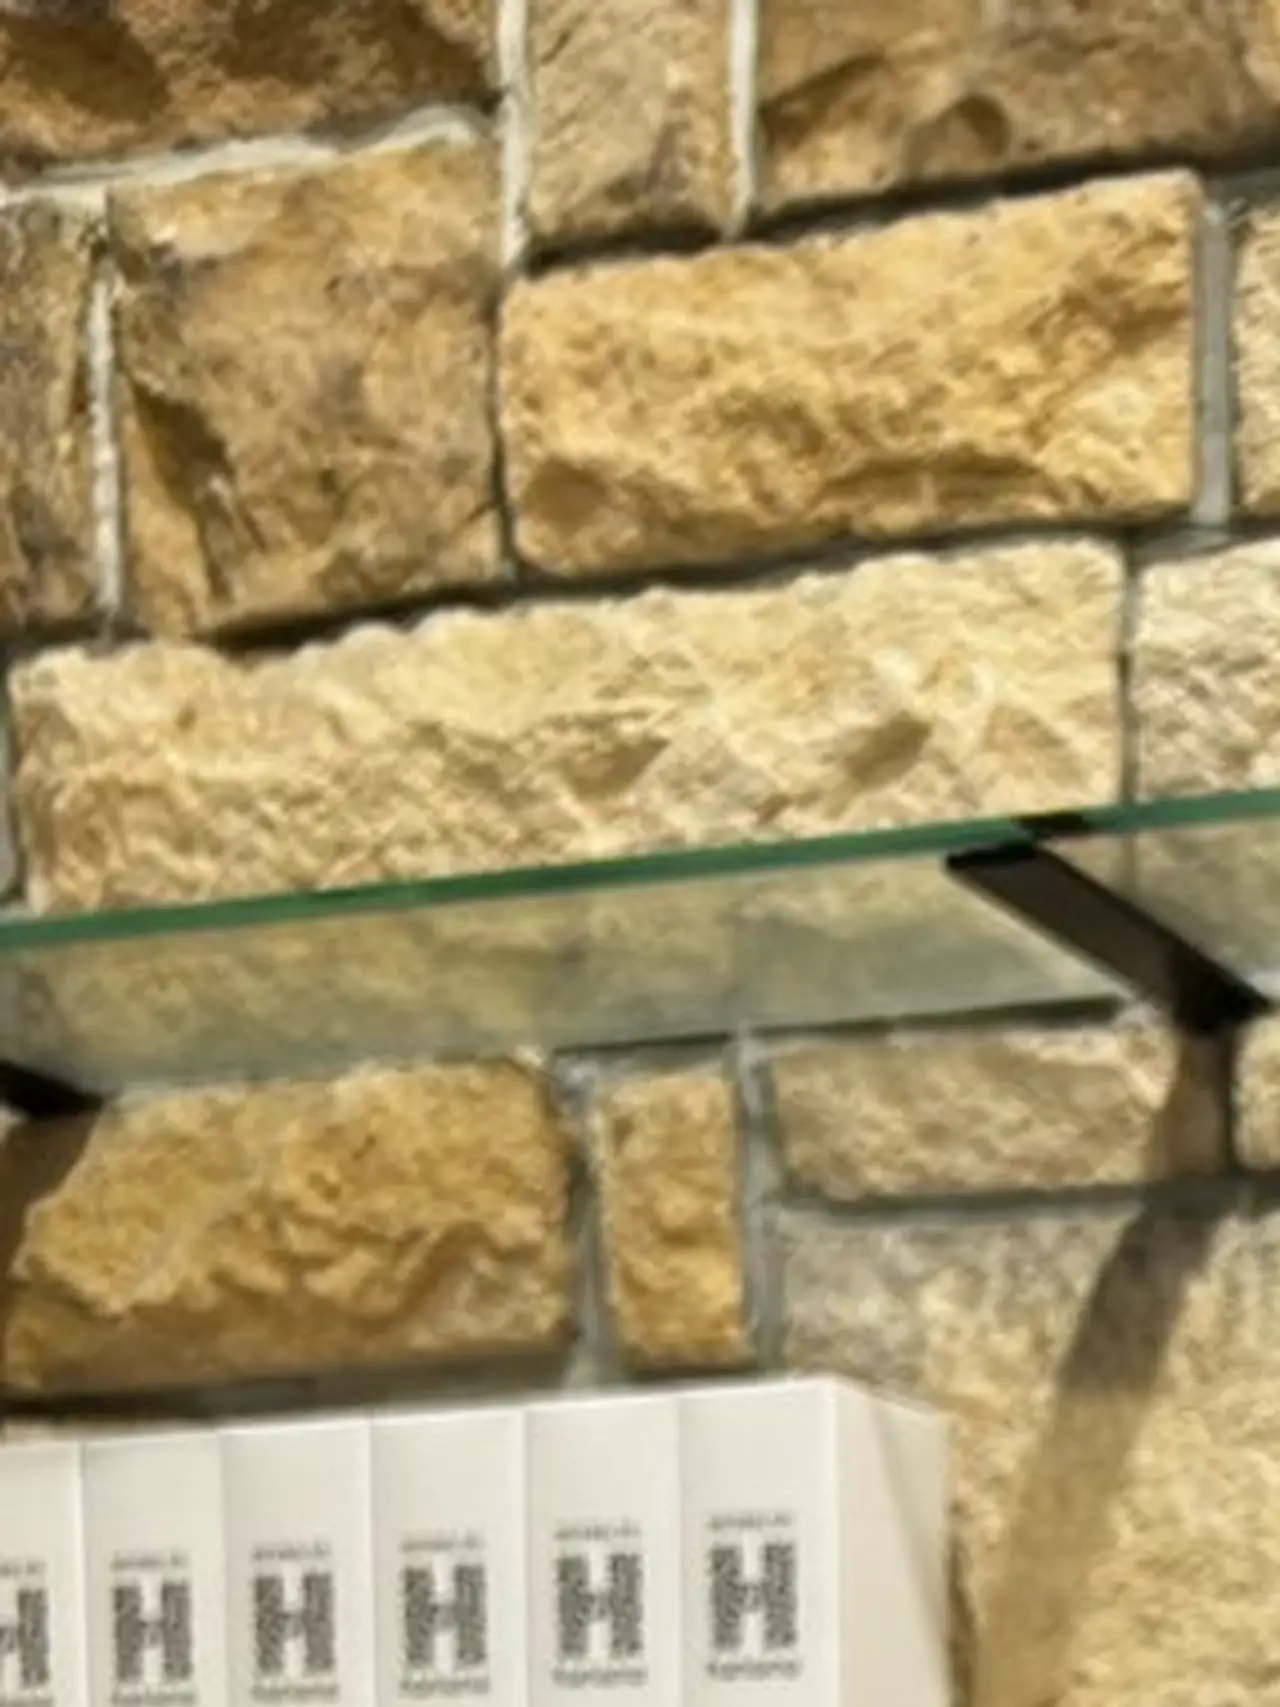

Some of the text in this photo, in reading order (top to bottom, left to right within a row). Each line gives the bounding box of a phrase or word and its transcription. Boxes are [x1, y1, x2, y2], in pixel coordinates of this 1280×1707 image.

[112, 1582, 193, 1683] H
[253, 1574, 334, 1675] H
[403, 1564, 487, 1667] H
[557, 1554, 642, 1658] H
[709, 1542, 797, 1650] H
